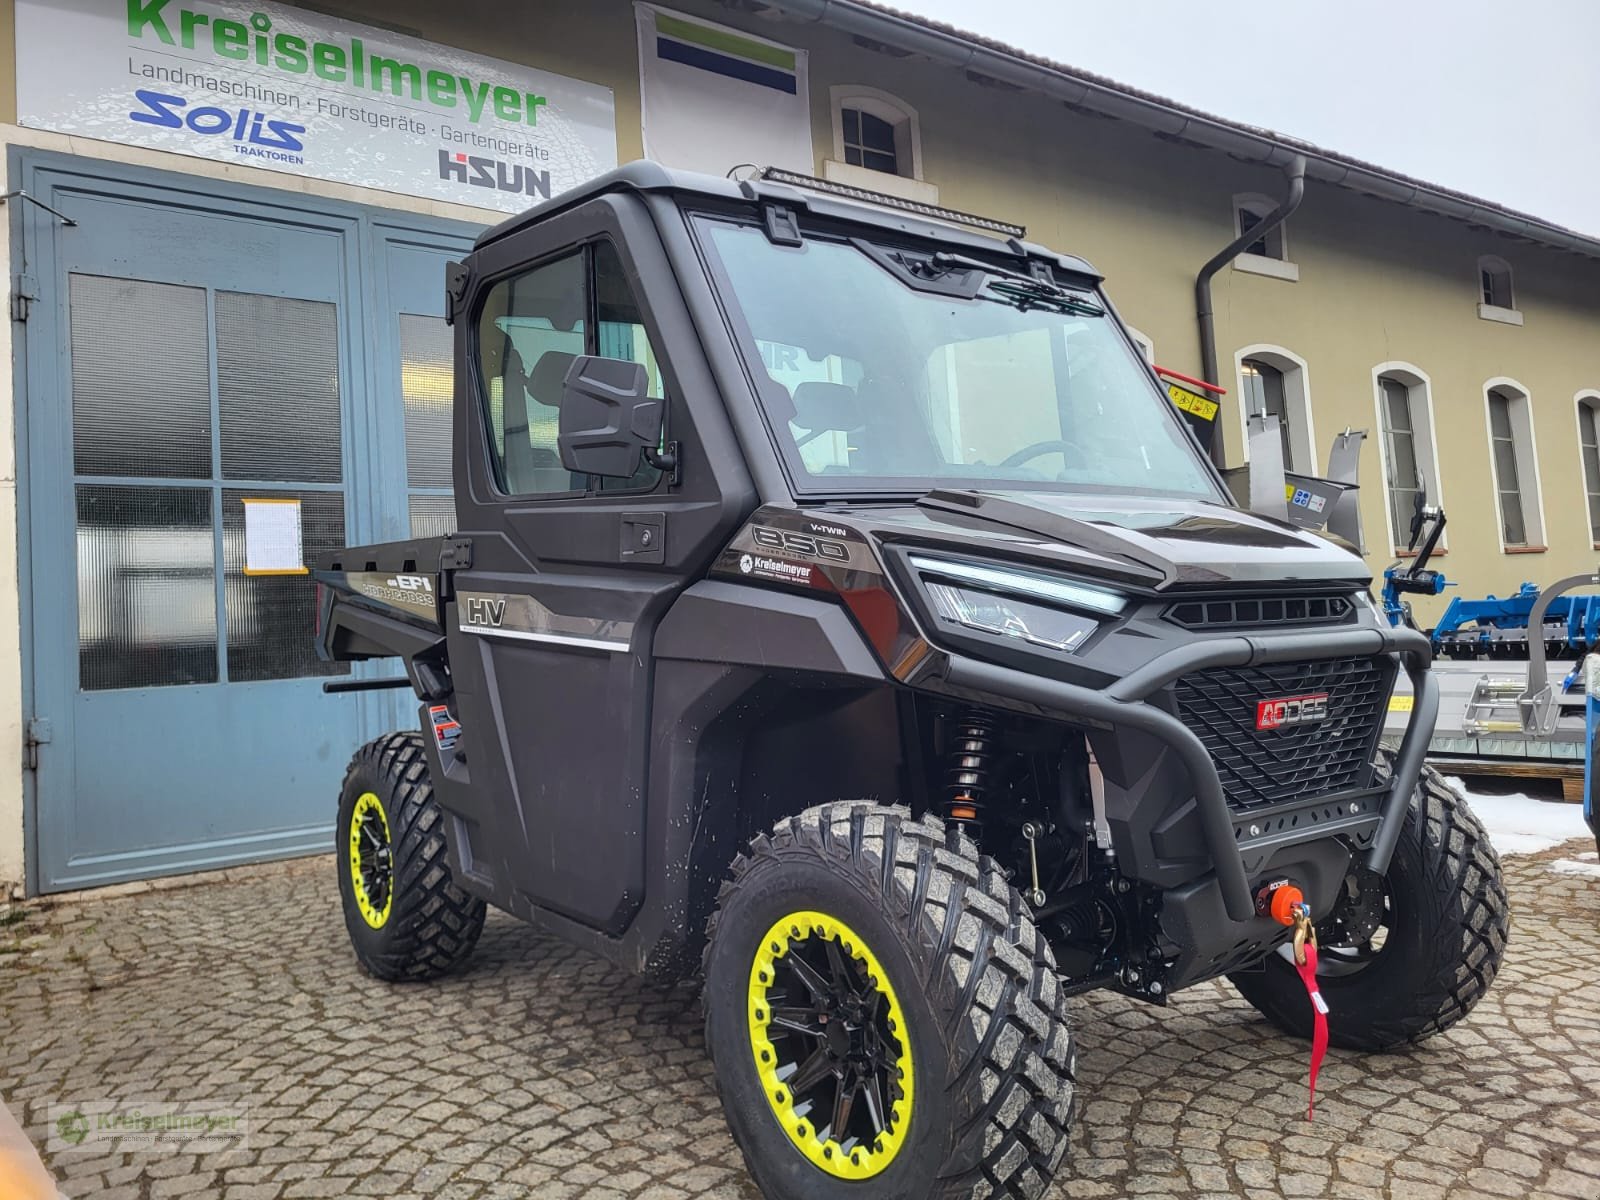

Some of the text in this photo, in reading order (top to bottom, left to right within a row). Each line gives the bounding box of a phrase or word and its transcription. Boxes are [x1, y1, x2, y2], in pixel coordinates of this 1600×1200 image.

[127, 0, 546, 127] Kreiselmeyer
[128, 56, 549, 161] Landmaschinen Forstgeräte Gartengeräte
[233, 144, 304, 165] TRAKTOREN
[810, 523, 847, 537] V-TWIN
[754, 556, 812, 577] Kreiselmeyer
[396, 575, 432, 592] EFI
[467, 597, 506, 626] HV
[1260, 697, 1328, 727] AODES
